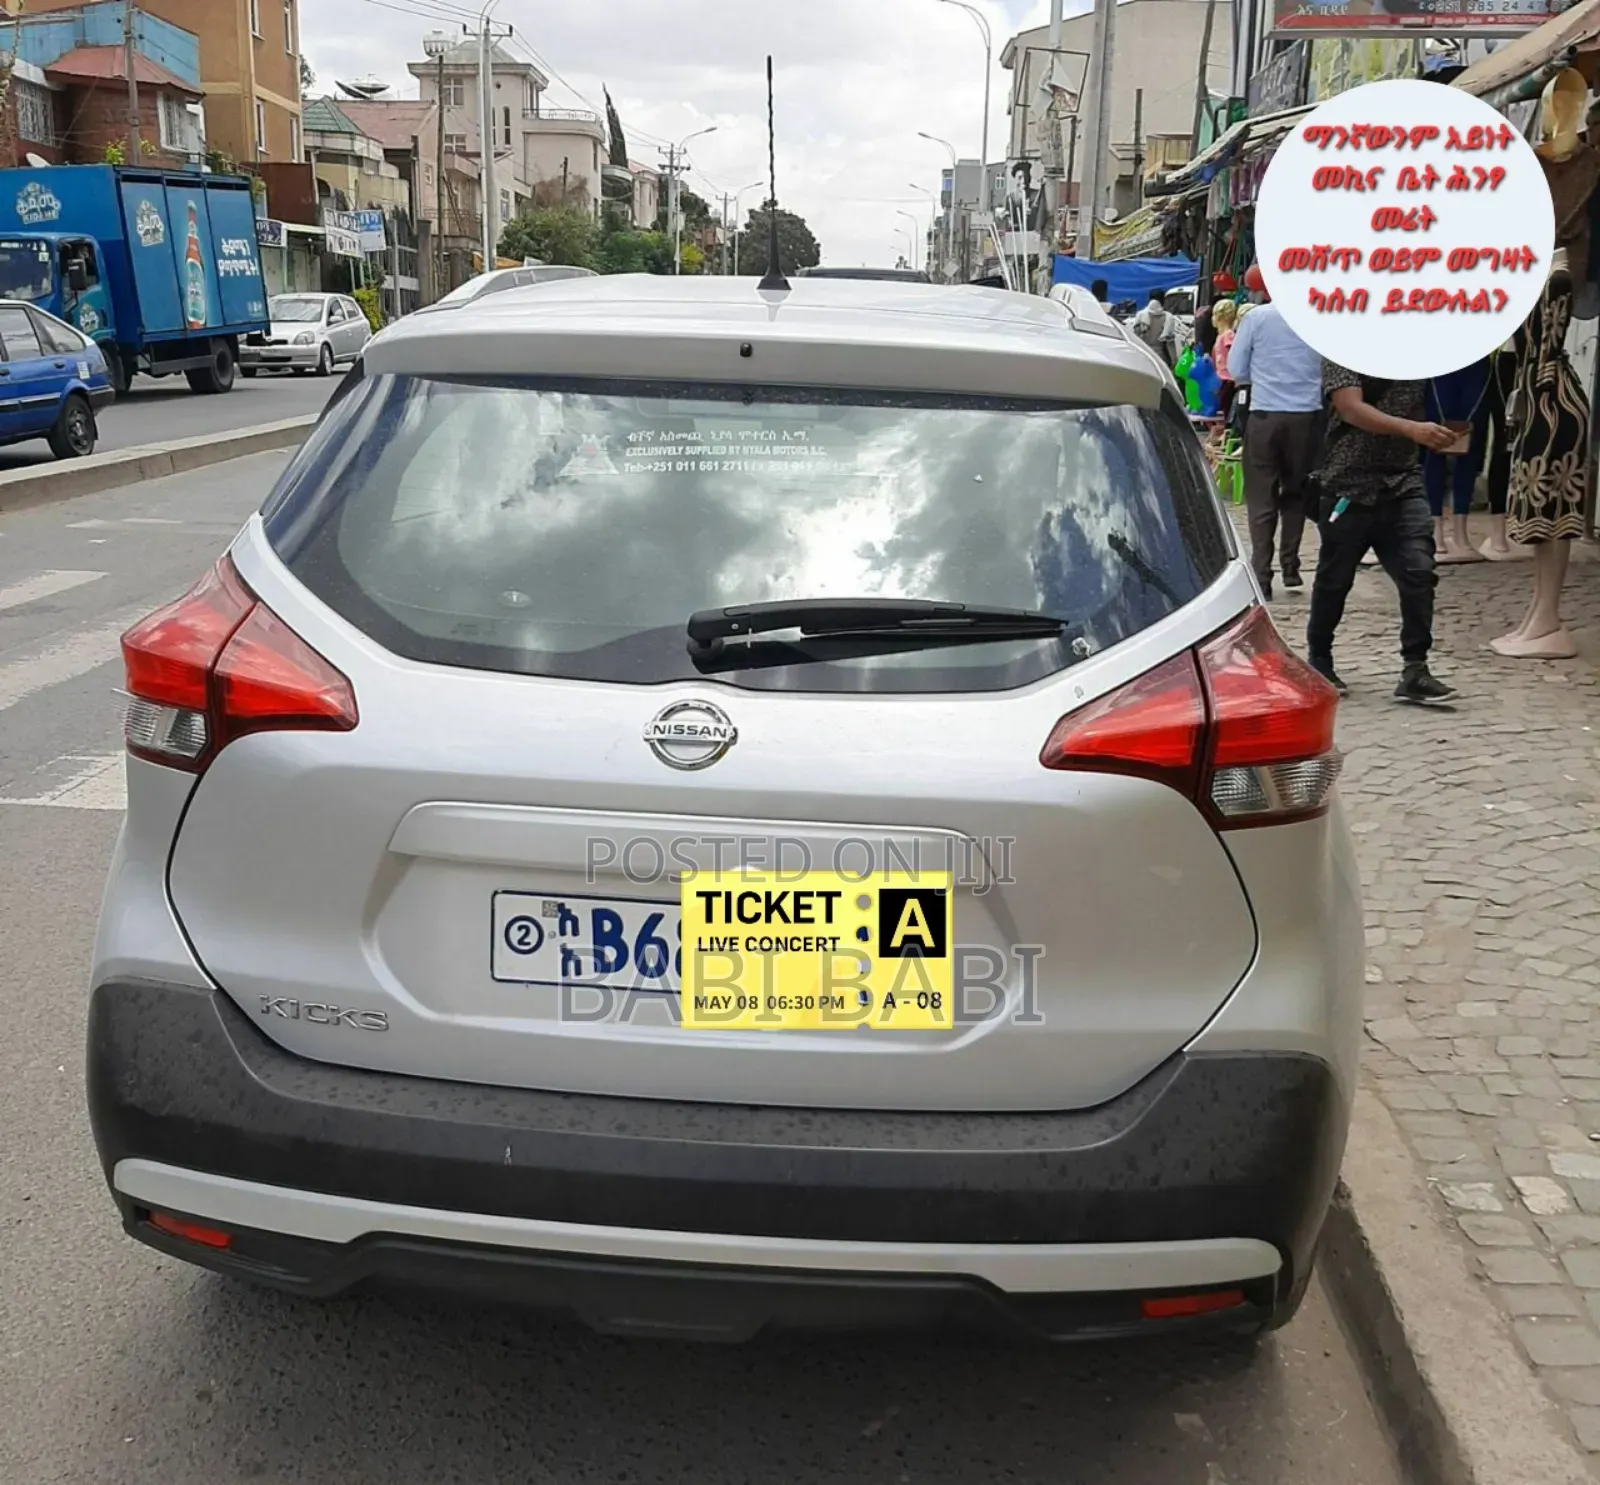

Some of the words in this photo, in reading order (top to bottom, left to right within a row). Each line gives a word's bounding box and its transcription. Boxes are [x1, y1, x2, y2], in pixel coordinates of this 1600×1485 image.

[1467, 1, 1494, 12] 985
[1502, 1, 1519, 11] 24
[625, 445, 684, 457] EXCLUSIVELY
[685, 445, 726, 456] SUPPLIED
[675, 460, 697, 472] 011
[699, 460, 720, 472] 661
[653, 723, 727, 739] NISSAN
[591, 907, 682, 979] B6
[259, 993, 390, 1032] KICKS
